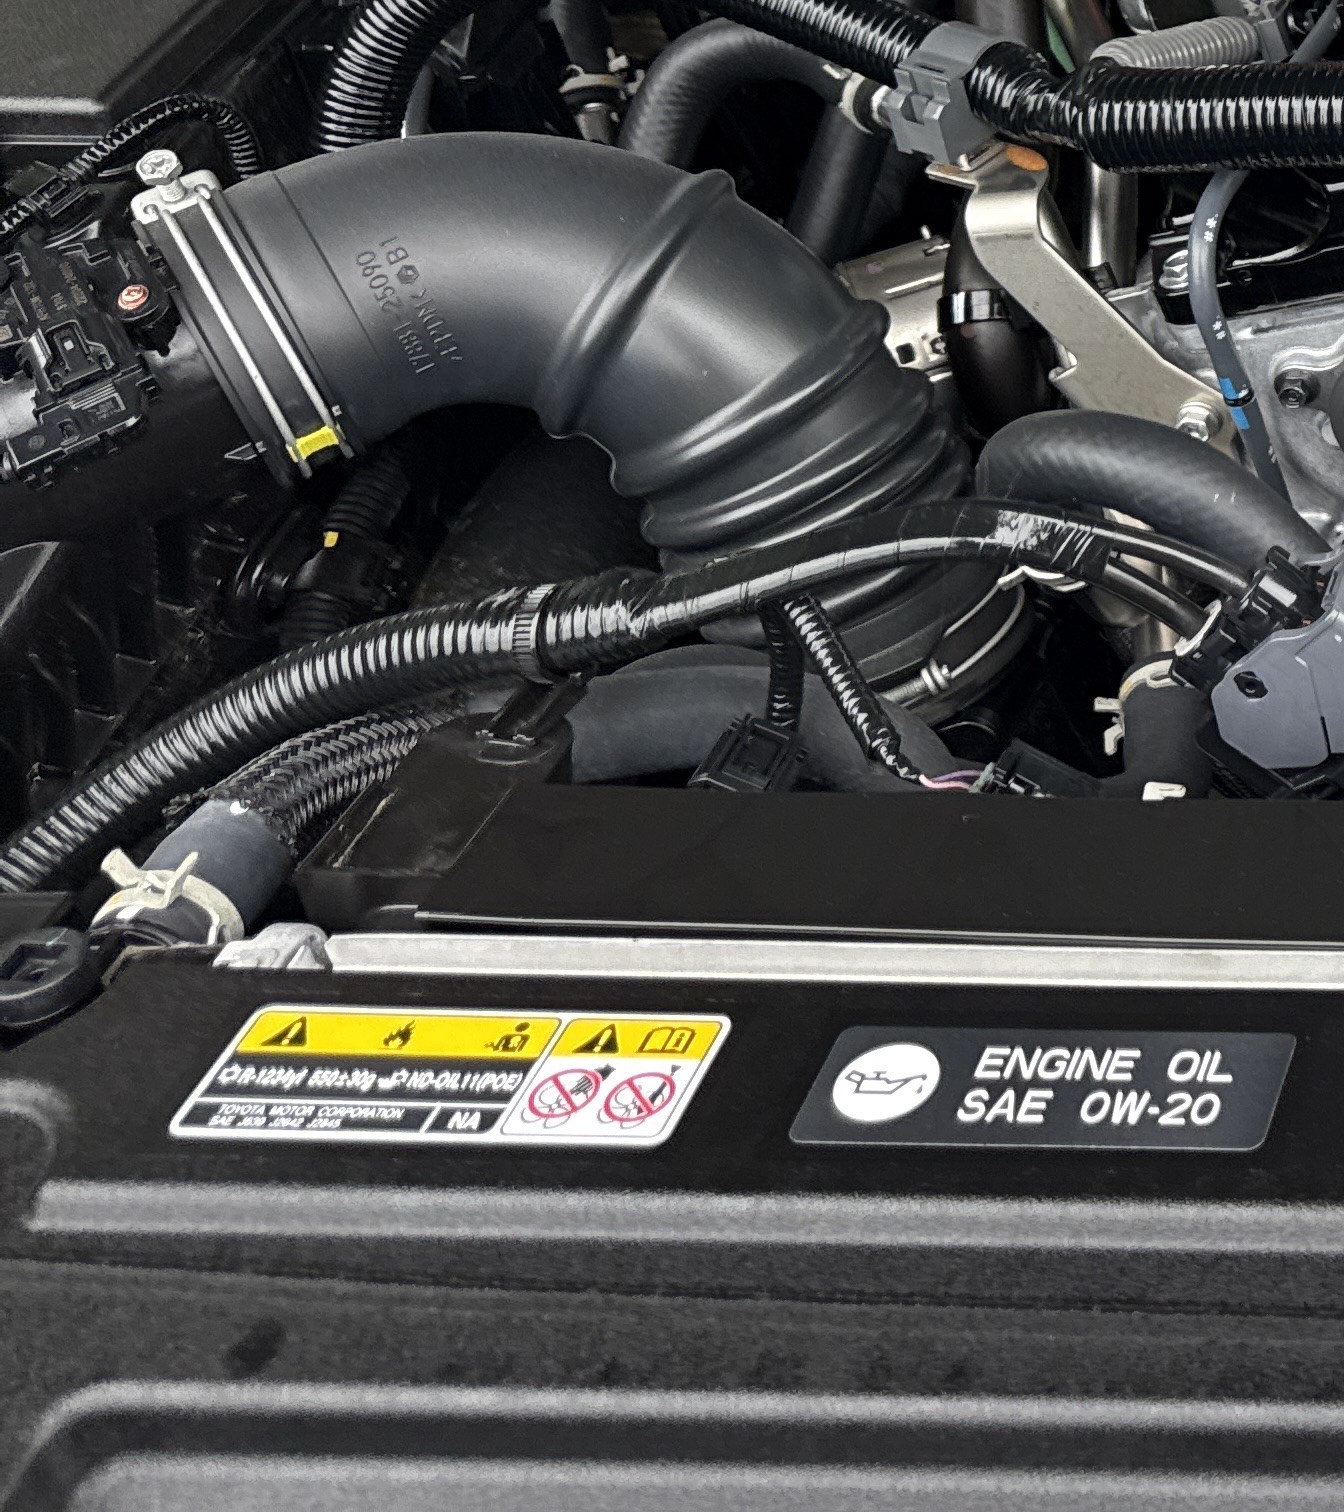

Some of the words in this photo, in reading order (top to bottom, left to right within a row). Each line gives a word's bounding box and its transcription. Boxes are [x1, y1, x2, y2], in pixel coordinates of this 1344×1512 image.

[974, 1047, 1141, 1083] ENGINE
[1167, 1049, 1234, 1084] OIL
[308, 1068, 376, 1091] 550±30g
[218, 1103, 266, 1116] TOYOTA
[270, 1104, 314, 1117] MOTOR
[318, 1105, 405, 1119] CORPORATION
[956, 1088, 1054, 1125] SAE
[1080, 1091, 1222, 1126] 0W-20
[208, 1115, 233, 1127] SAE
[448, 1112, 482, 1130] NA
